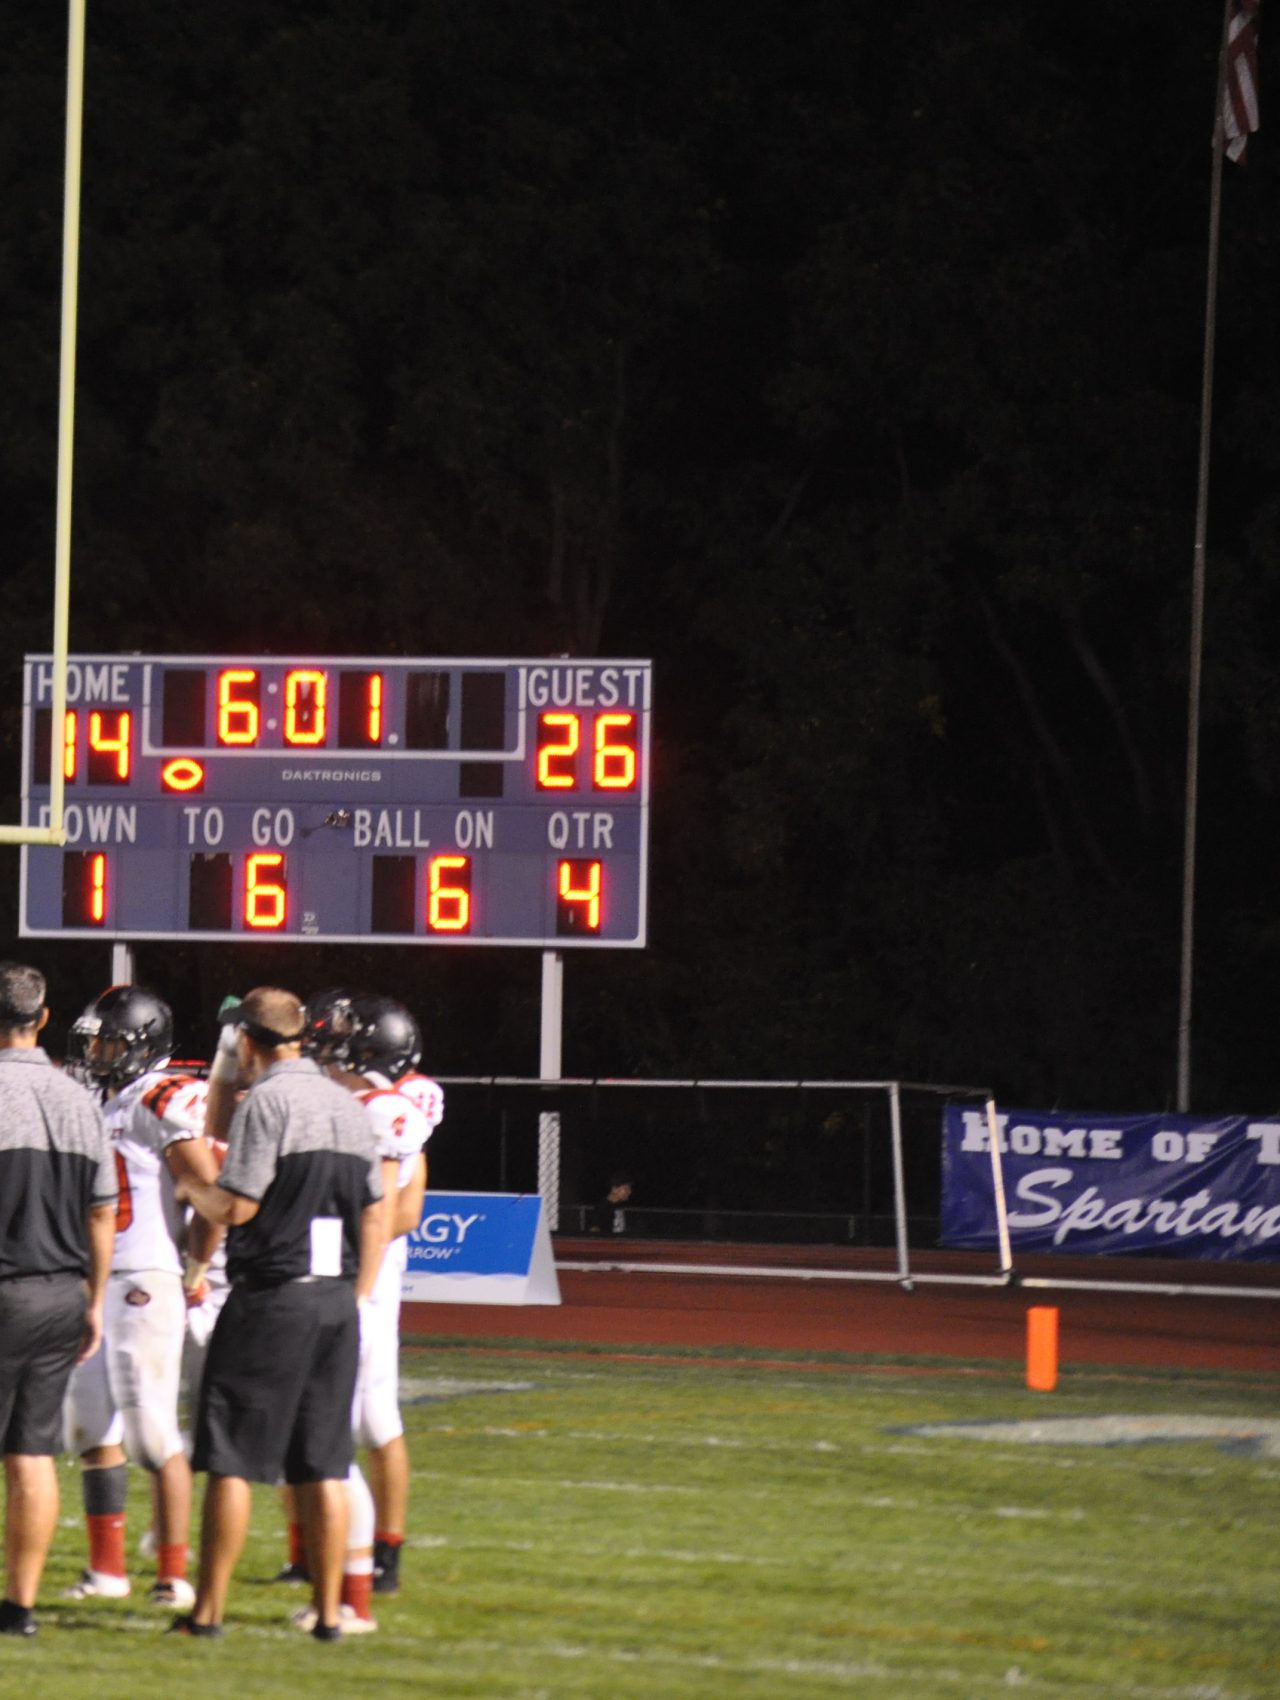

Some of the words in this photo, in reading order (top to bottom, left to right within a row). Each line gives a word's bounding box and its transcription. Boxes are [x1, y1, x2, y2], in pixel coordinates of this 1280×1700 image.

[38, 664, 130, 702] HOME
[528, 668, 642, 707] GUEST
[63, 711, 130, 779] 14
[538, 713, 636, 788] 26
[281, 769, 382, 782] DAKTRONICS
[183, 807, 223, 846] TO
[251, 808, 295, 847] GO
[353, 809, 430, 848] BALL
[455, 810, 494, 849] ON
[547, 811, 615, 850] QTR
[92, 853, 105, 922] 1
[245, 853, 286, 928] 6
[429, 855, 470, 930] 6
[559, 861, 602, 930] 4
